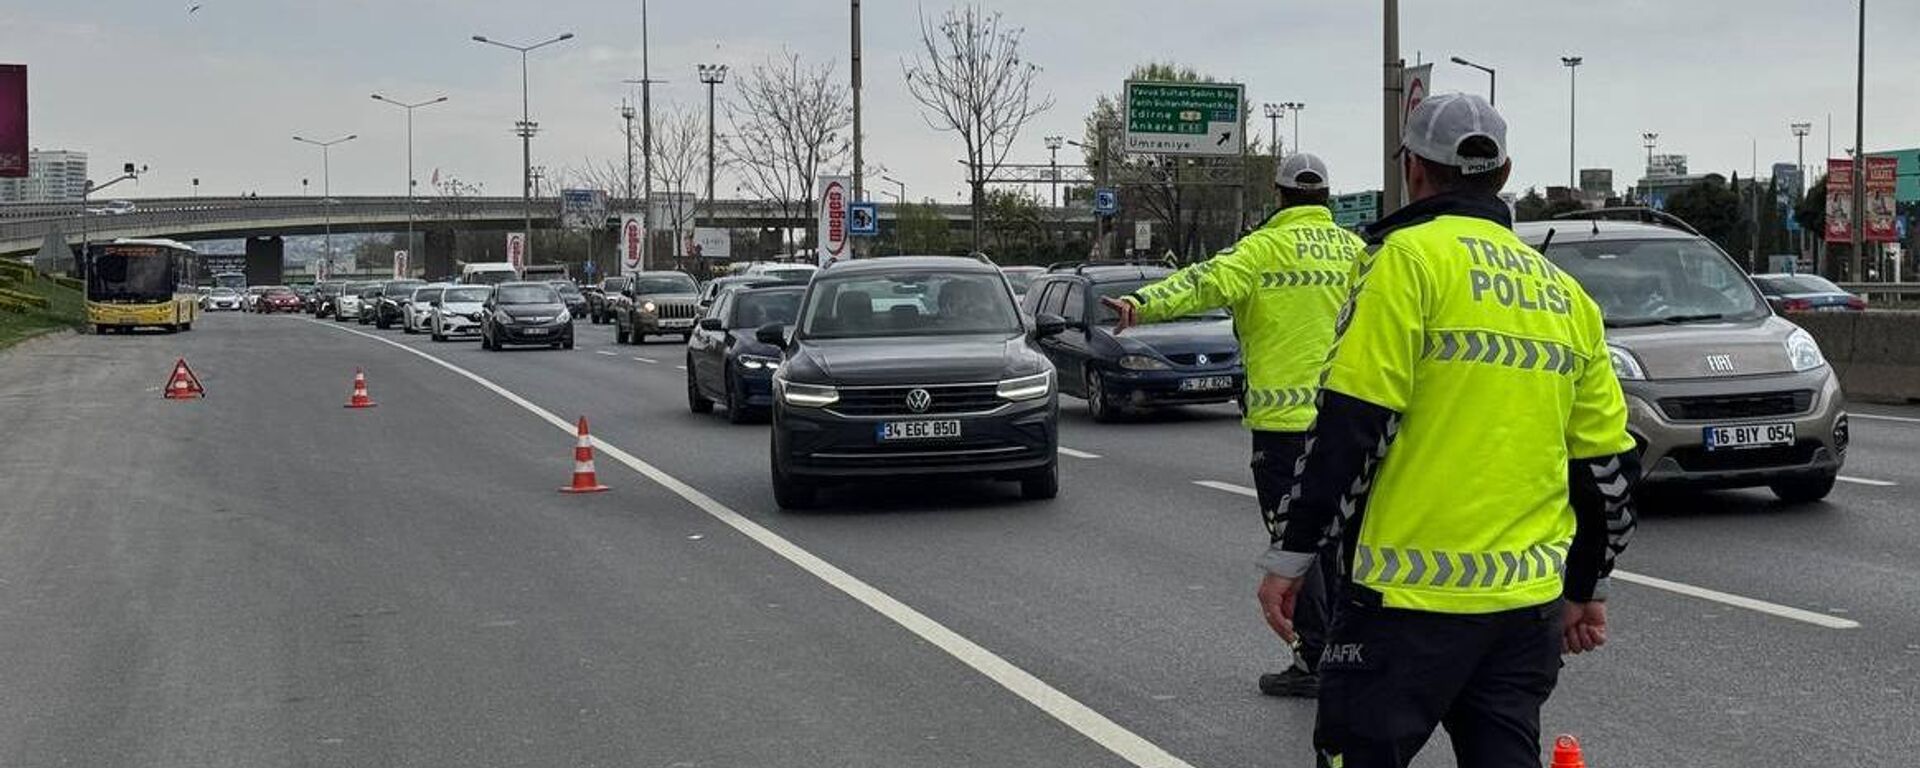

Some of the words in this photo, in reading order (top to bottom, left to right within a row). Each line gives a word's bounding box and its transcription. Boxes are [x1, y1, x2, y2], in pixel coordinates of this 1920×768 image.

[1160, 88, 1189, 97] Sultan
[1131, 109, 1172, 119] Edirne
[1131, 121, 1175, 131] Ankara
[1706, 354, 1734, 371] FIAT
[885, 423, 901, 437] 34
[905, 422, 929, 436] EGC
[933, 421, 957, 435] 850
[1714, 429, 1730, 444] 16
[1735, 427, 1760, 443] BIY
[1767, 424, 1793, 441] 054
